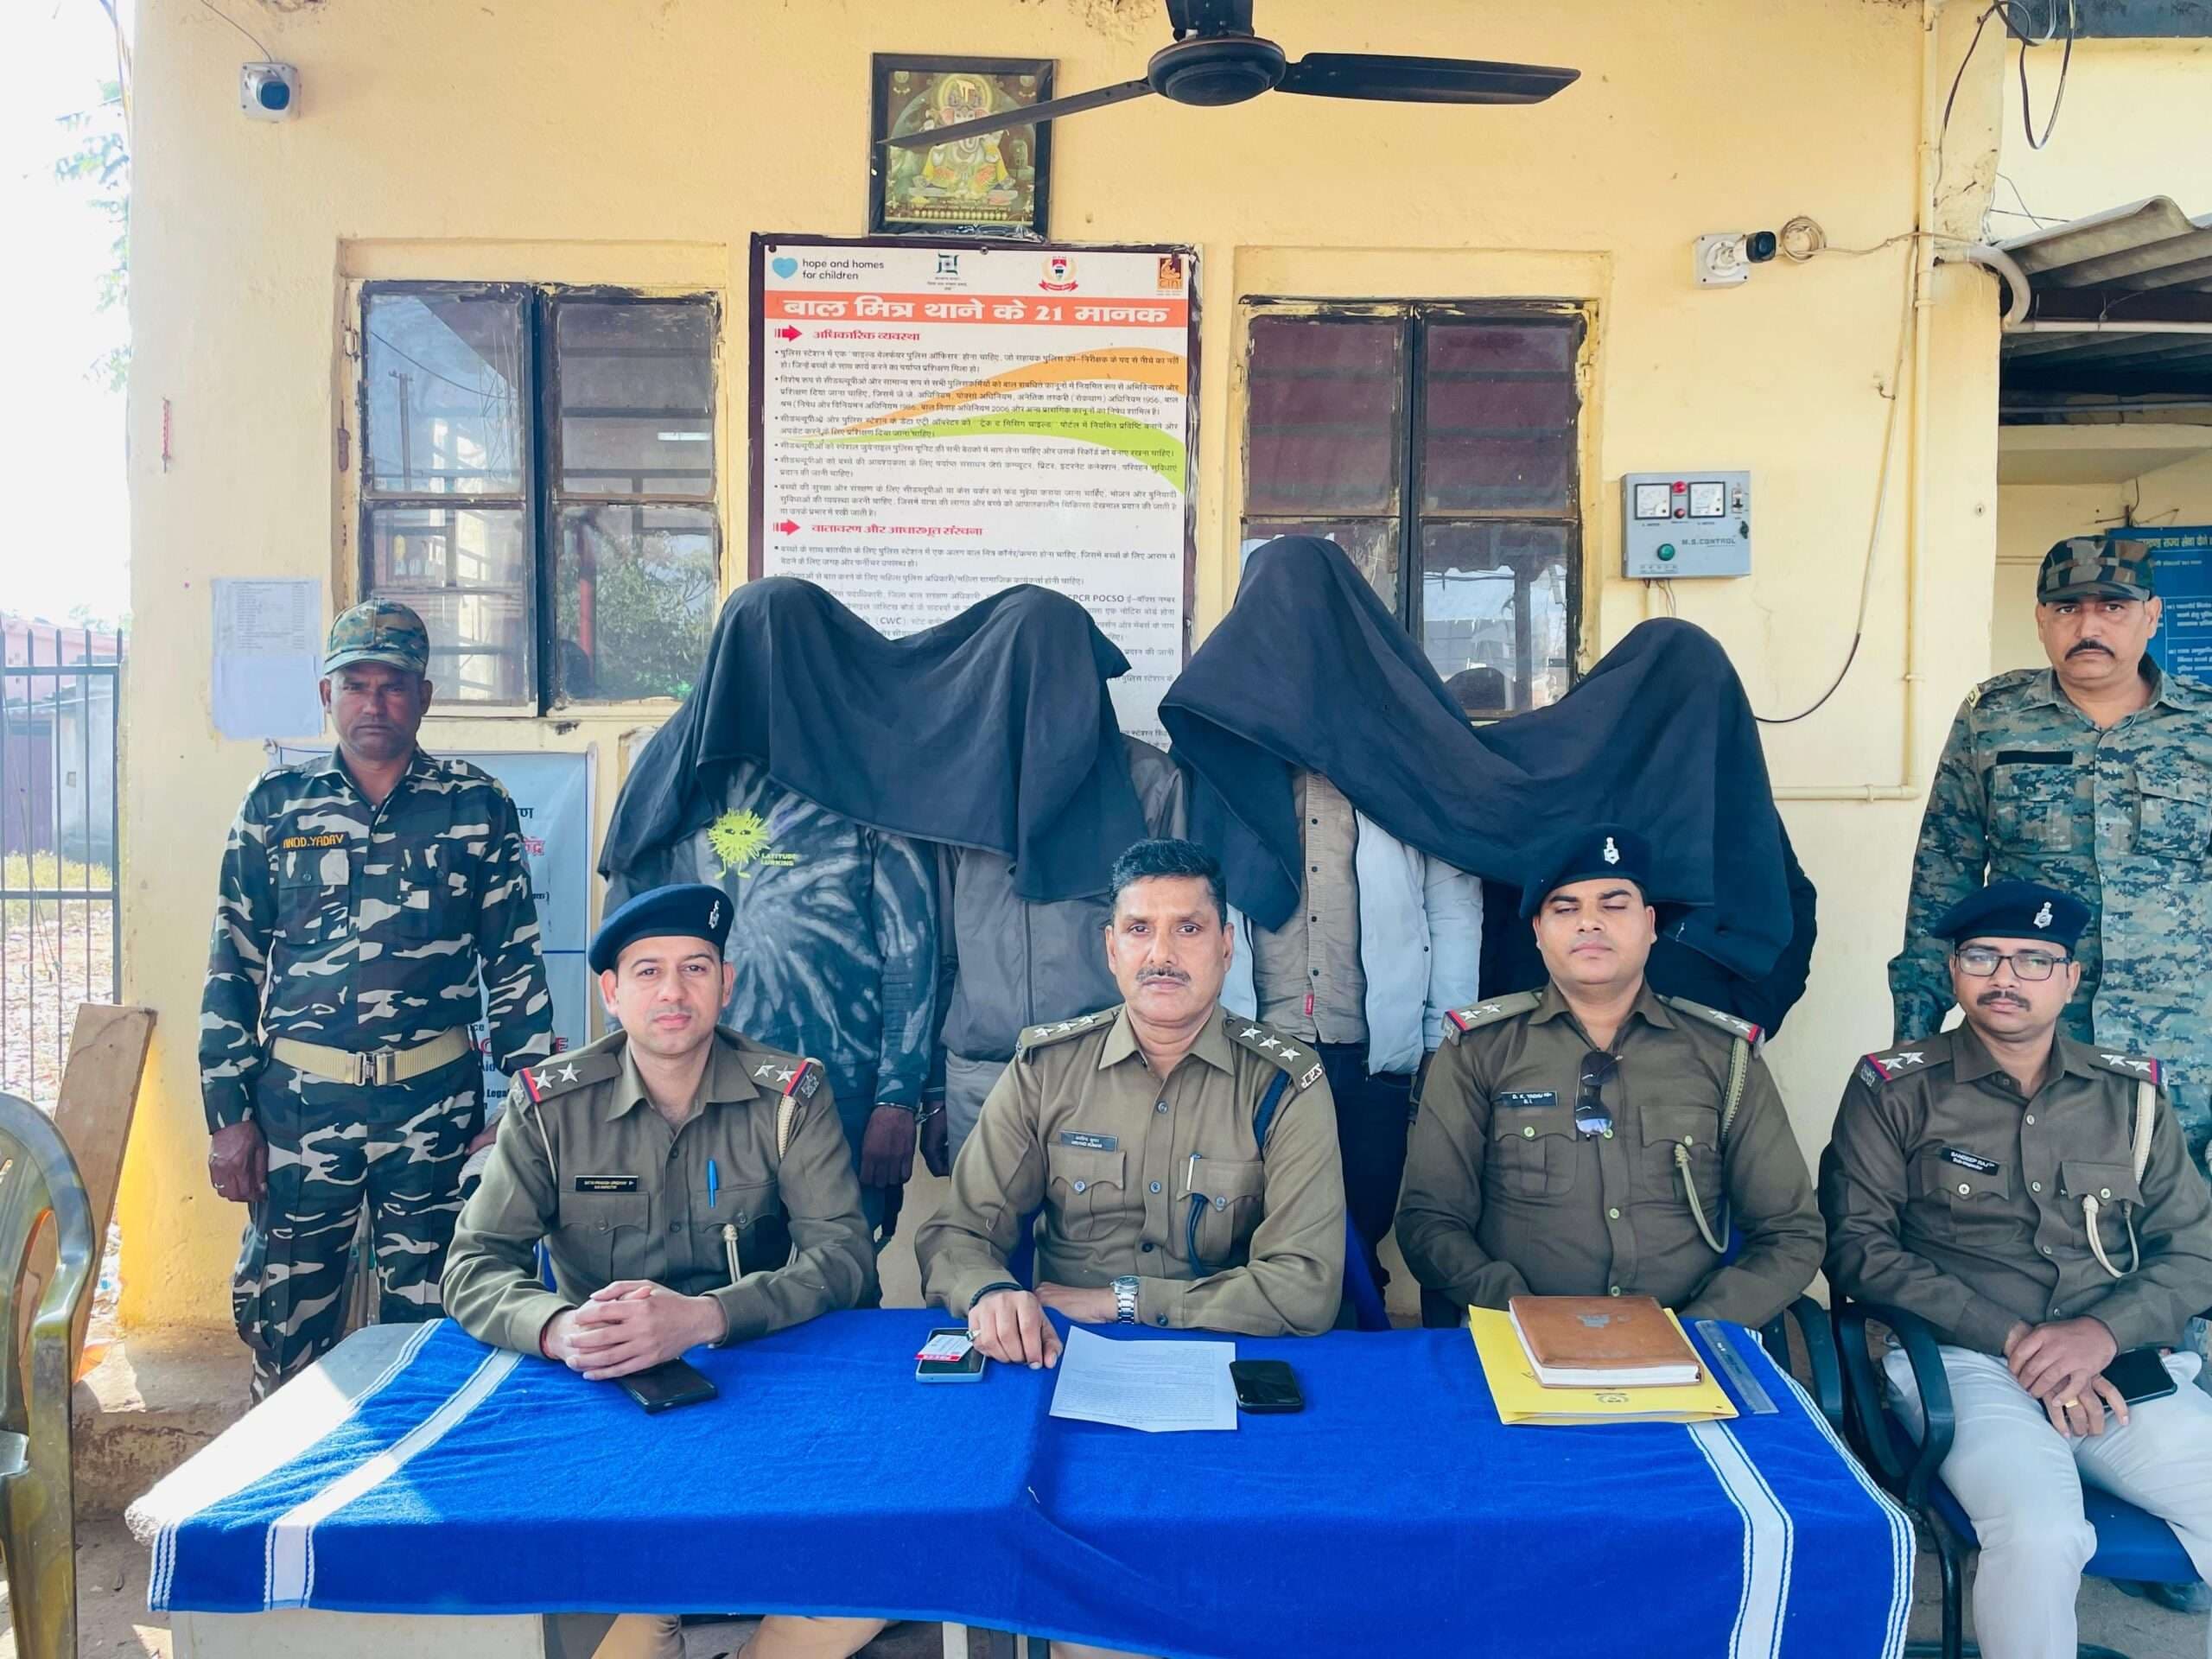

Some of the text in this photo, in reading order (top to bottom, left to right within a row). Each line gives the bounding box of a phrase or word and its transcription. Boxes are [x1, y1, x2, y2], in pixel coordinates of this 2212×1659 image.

[803, 259, 885, 270] hope and homes
[803, 270, 859, 280] for children
[783, 295, 1171, 323] बाल मित्र थाने के 21 मानक
[877, 331, 921, 341] व्यवस्था
[863, 524, 887, 533] और
[1092, 594, 1125, 603] POCSO
